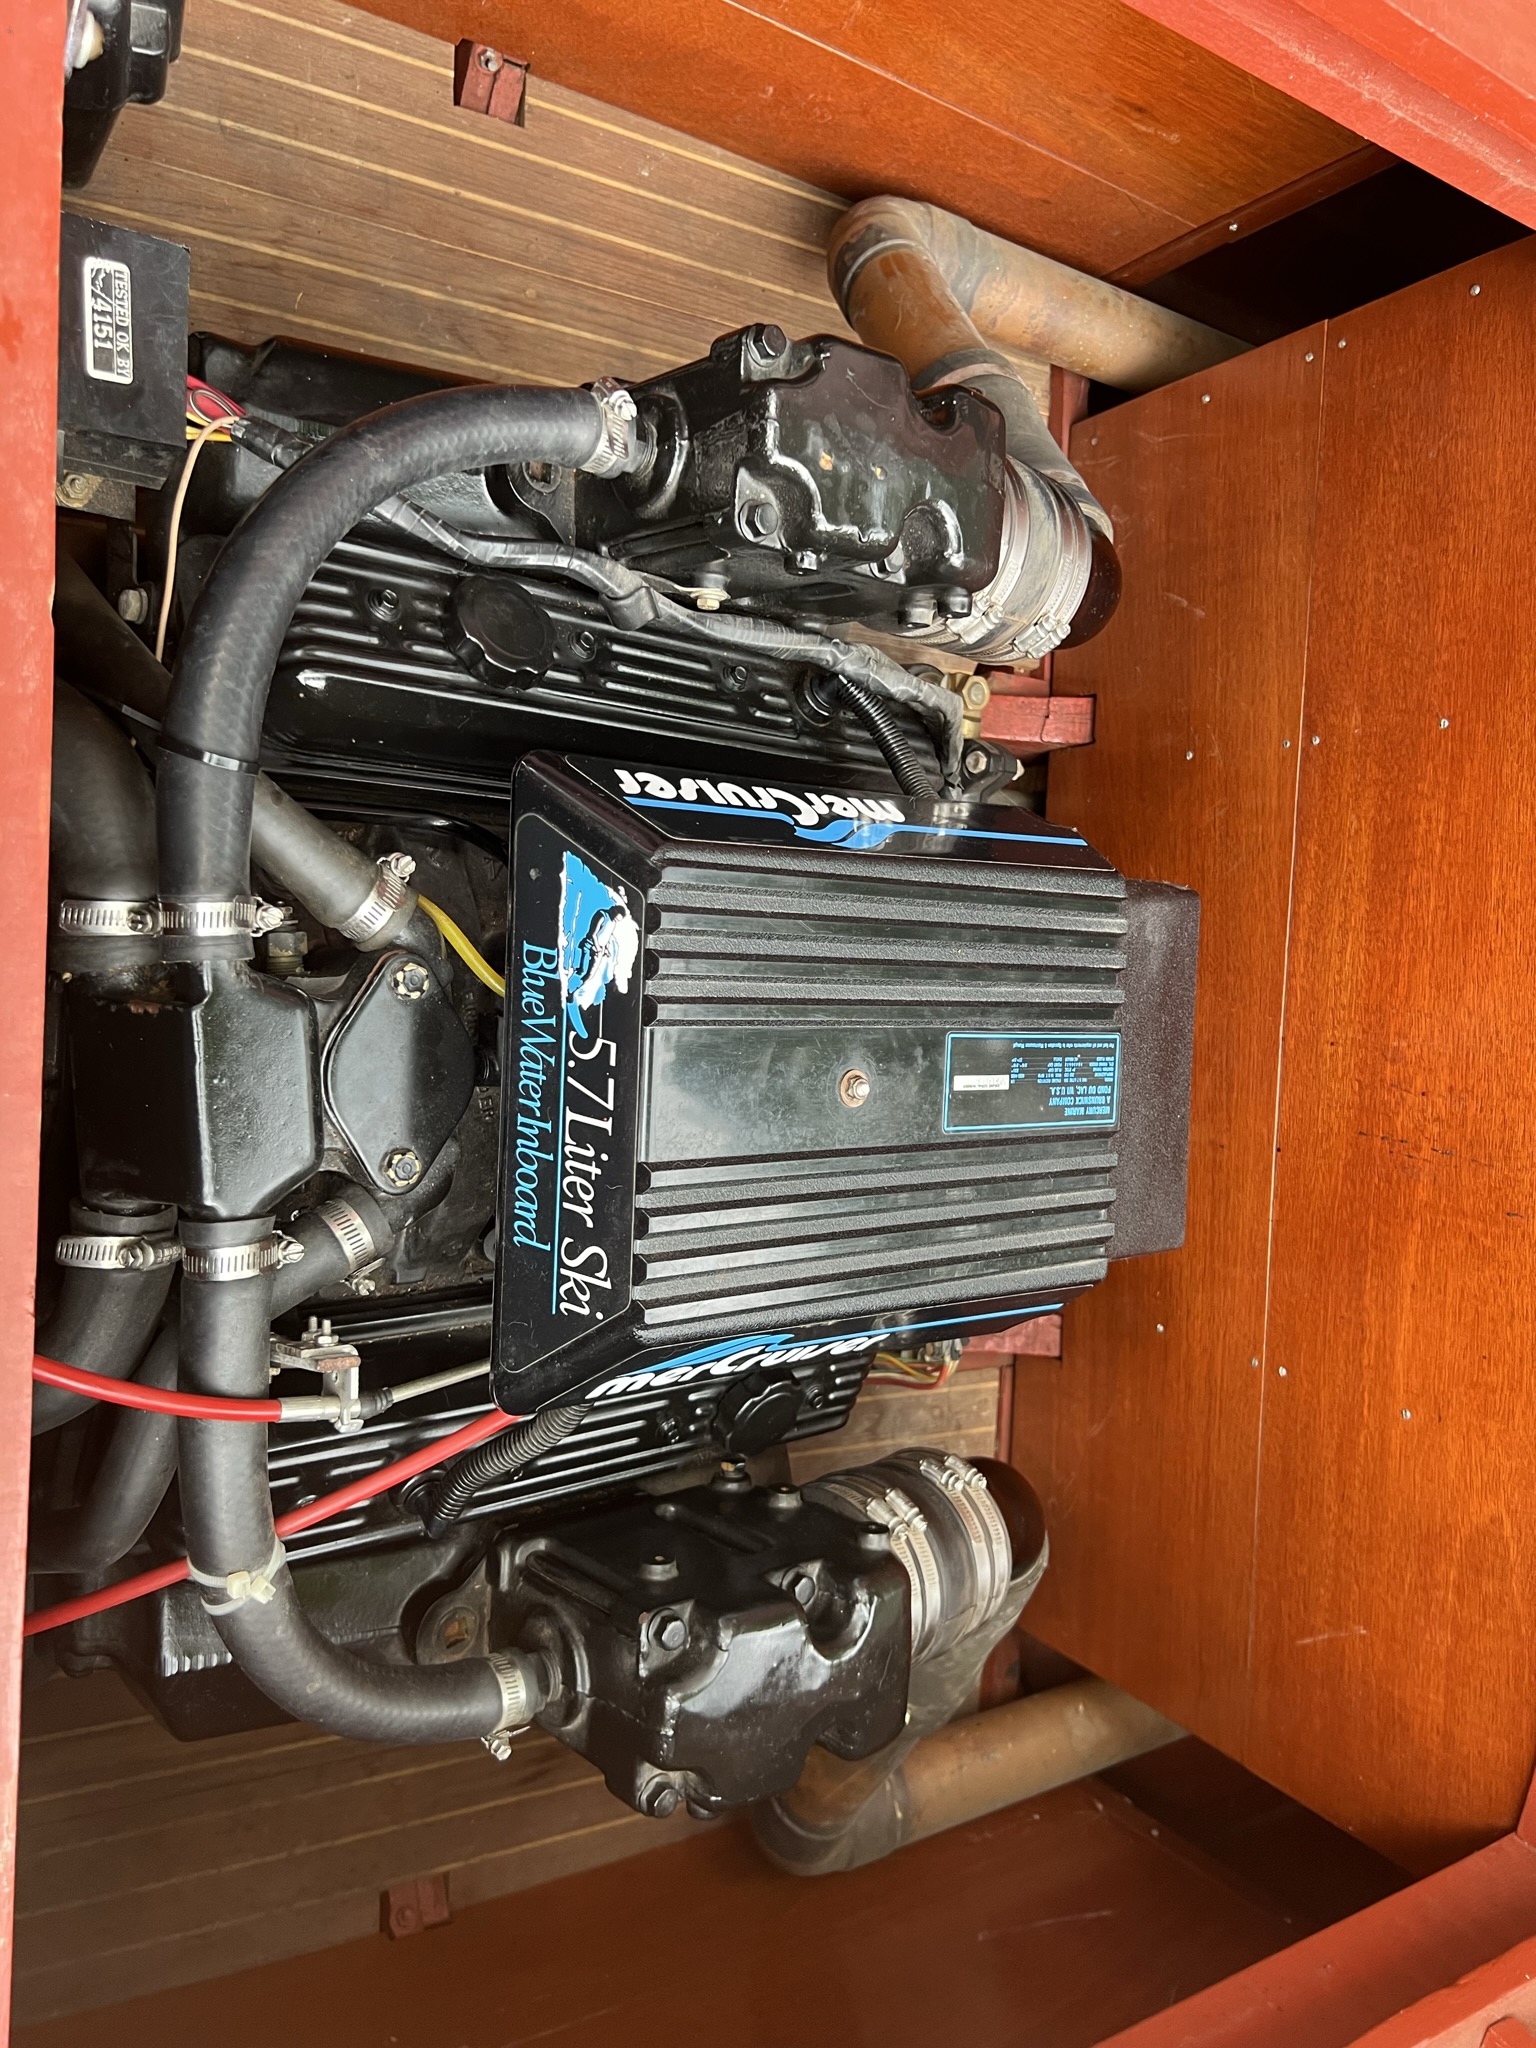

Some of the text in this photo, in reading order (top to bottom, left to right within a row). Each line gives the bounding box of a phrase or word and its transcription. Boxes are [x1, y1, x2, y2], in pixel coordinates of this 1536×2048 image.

[93, 297, 114, 350] 4151
[115, 271, 131, 378] TESTED OK BY
[1048, 1095, 1111, 1106] A BRUNSWICK COMPANY
[1097, 1085, 1111, 1094] FOND
[1064, 1106, 1110, 1116] MERCURY MARINE
[559, 1237, 613, 1320] Ski
